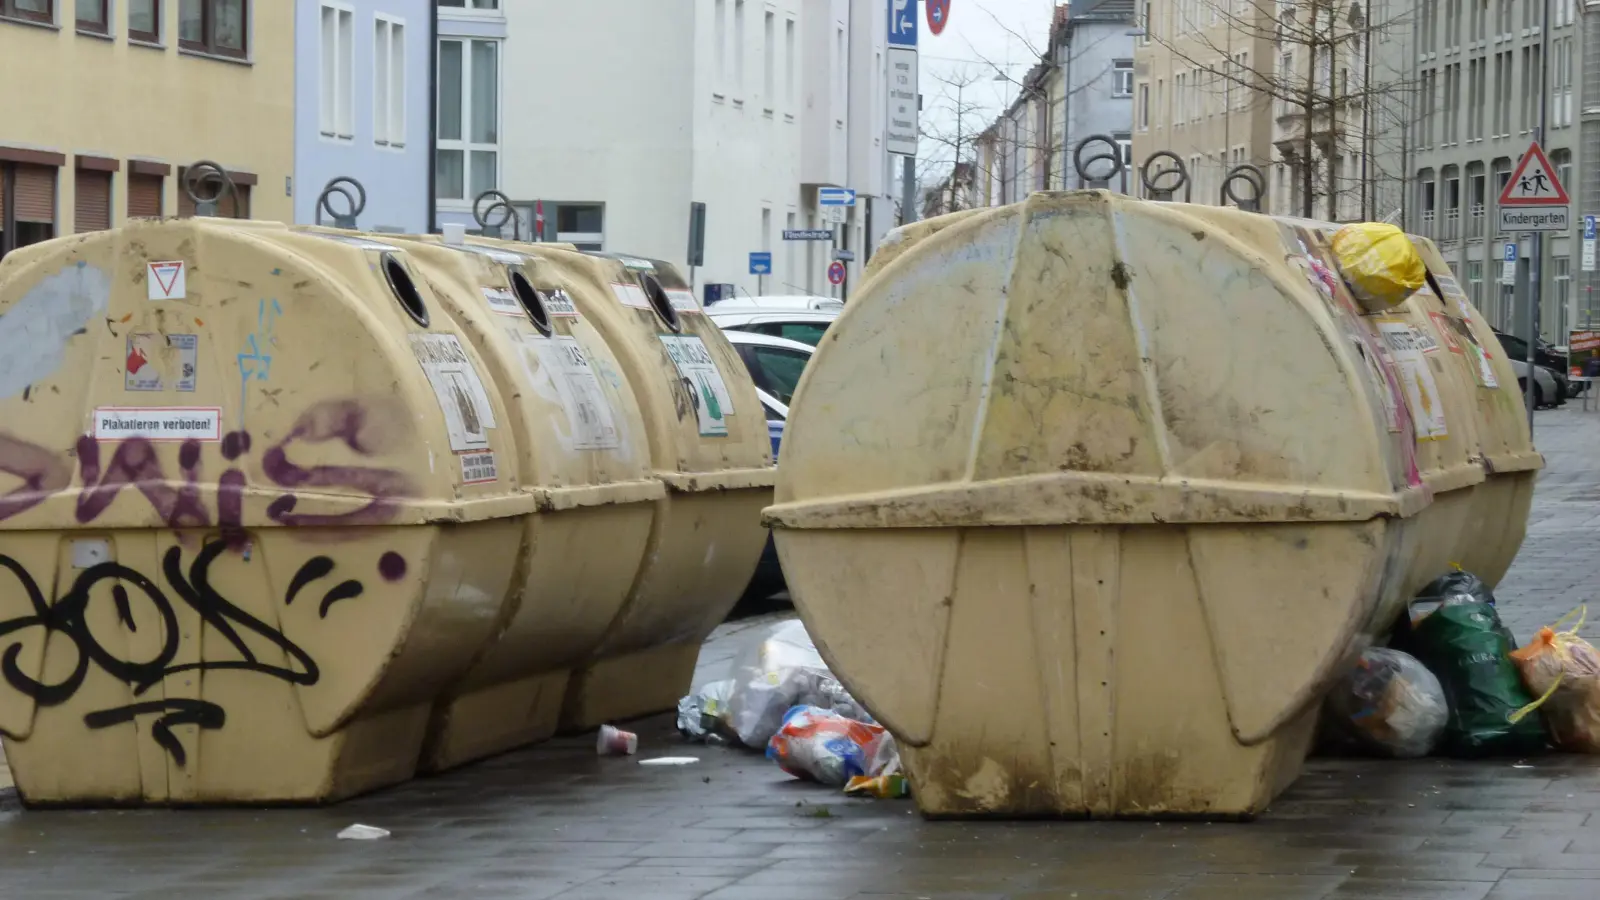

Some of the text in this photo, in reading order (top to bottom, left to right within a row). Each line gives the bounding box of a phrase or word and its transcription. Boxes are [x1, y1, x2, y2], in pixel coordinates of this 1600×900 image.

[1503, 212, 1565, 227] Kindergarten
[102, 418, 211, 430] Plakatieren verboten!
